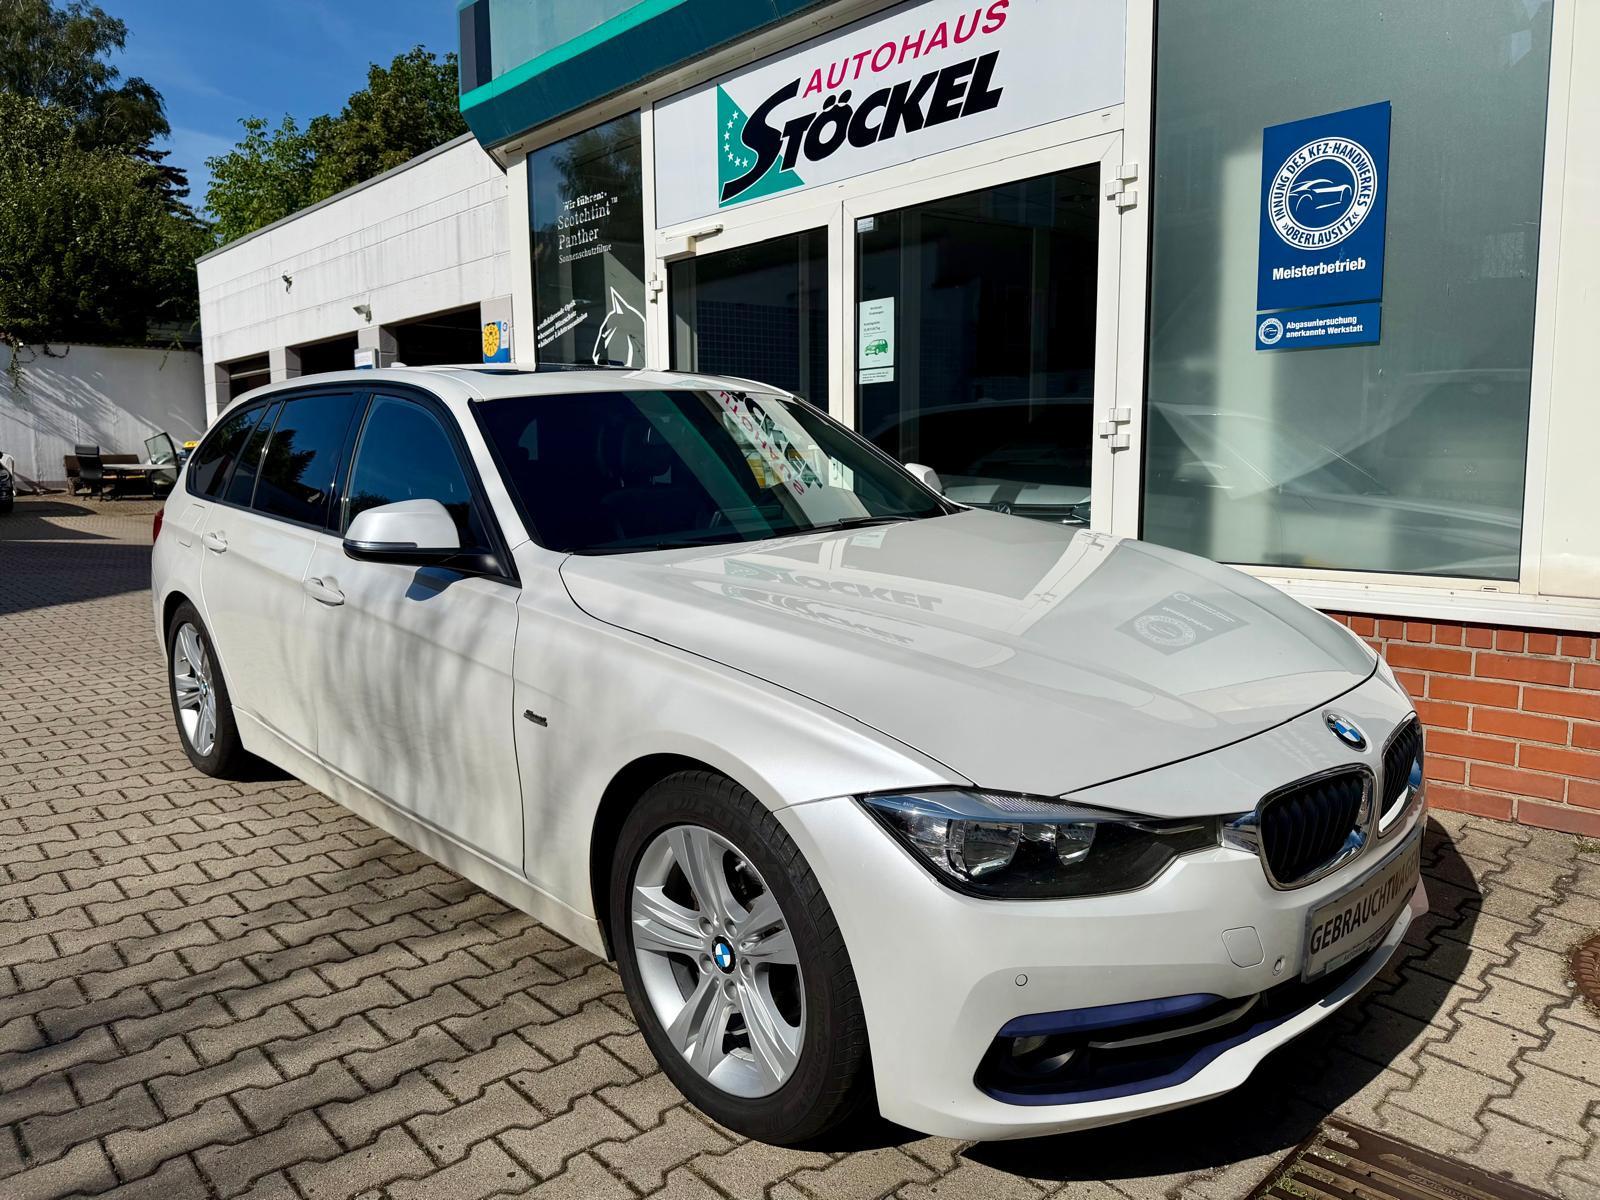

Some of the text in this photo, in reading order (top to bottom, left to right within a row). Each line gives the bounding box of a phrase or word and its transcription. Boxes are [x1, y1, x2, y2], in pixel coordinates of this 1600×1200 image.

[802, 0, 1010, 99] AUTOHAUS
[720, 50, 1004, 203] STÖCKEL
[1273, 142, 1372, 222] INNUNG DES KFZ-HANDWERKES
[558, 228, 599, 250] Panther
[1272, 257, 1366, 280] Meisterbetrieb
[1285, 328, 1326, 338] anerkannte
[1327, 324, 1363, 335] Werkstatt
[1286, 316, 1357, 330] Abgasuntersuchung
